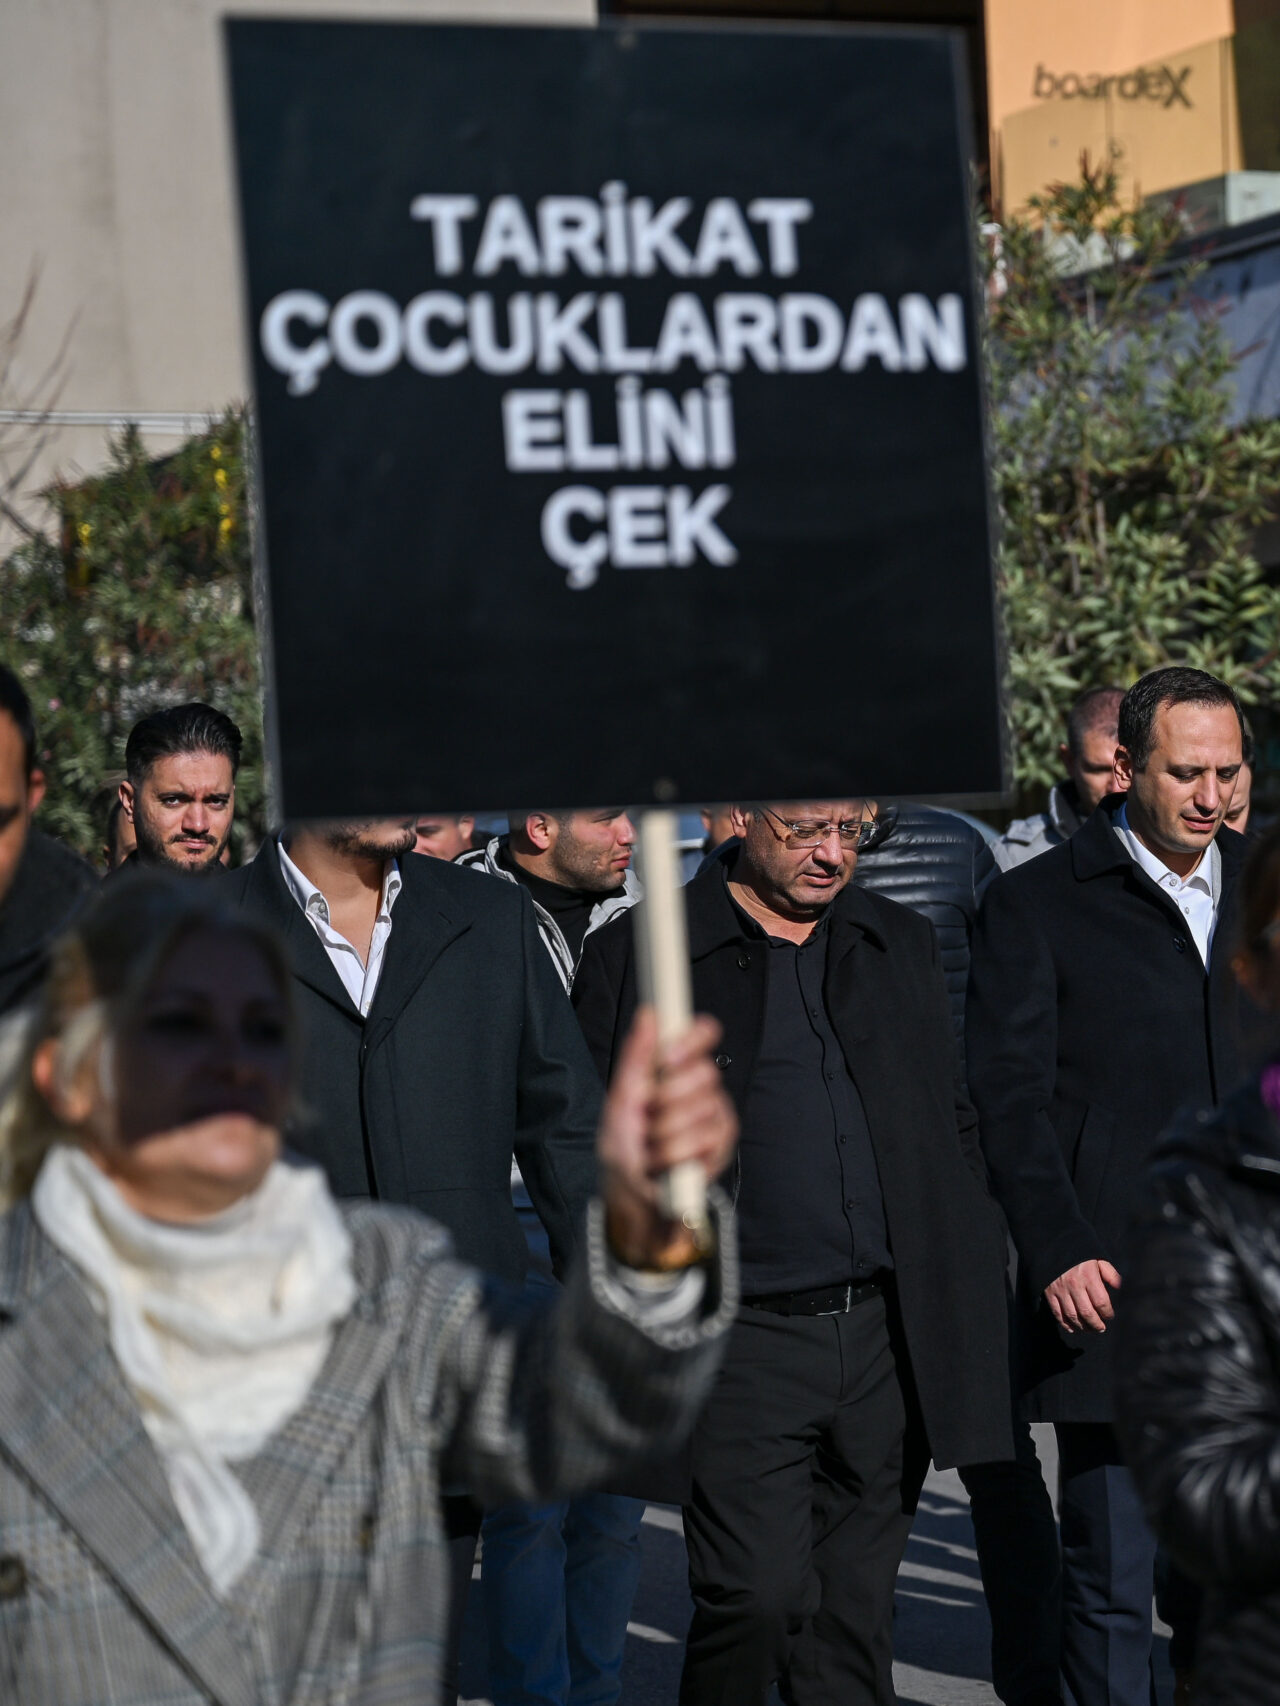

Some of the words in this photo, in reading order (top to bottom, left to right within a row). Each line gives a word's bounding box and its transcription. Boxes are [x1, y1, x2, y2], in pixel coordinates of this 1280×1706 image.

[411, 181, 812, 276] TARİKAT
[261, 291, 966, 394] ÇOCUKLARDAN
[503, 374, 735, 471] ELİNİ
[541, 485, 736, 588] ÇEK
